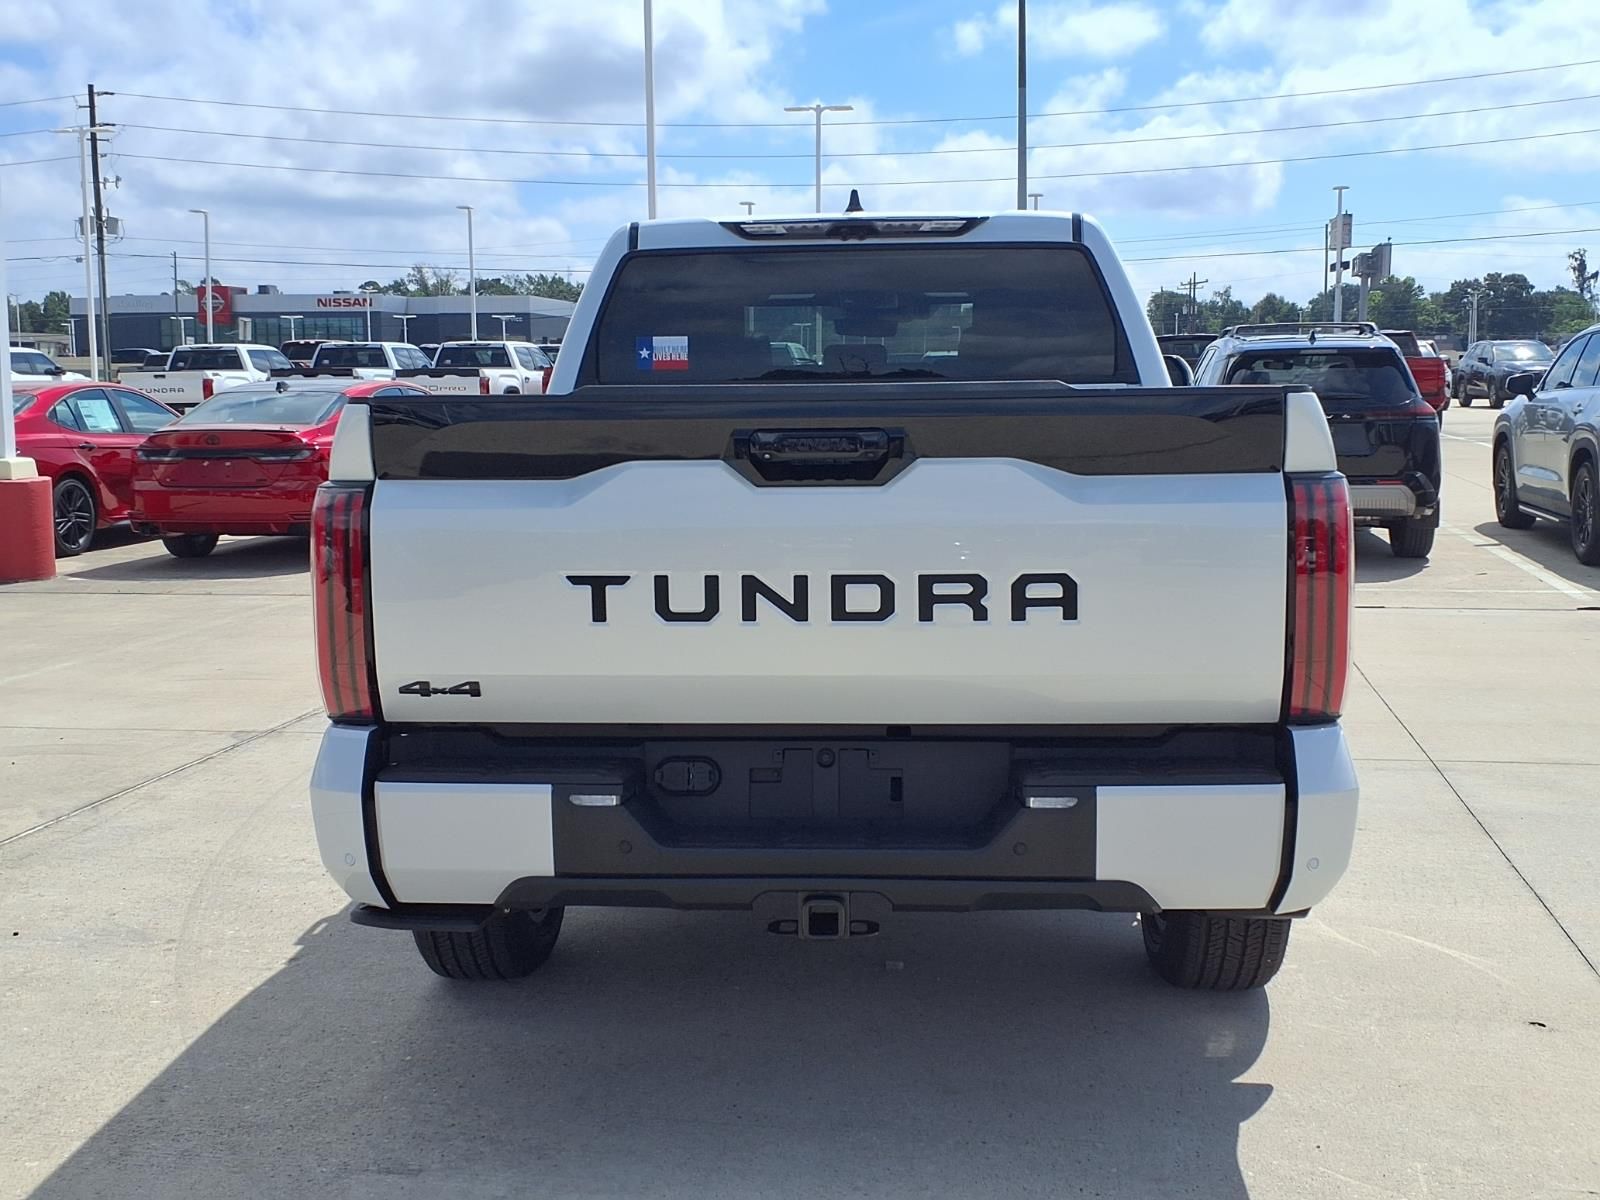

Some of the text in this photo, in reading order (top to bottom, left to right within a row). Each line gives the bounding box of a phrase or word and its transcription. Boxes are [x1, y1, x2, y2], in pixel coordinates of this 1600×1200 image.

[317, 297, 372, 307] NISSAN
[565, 573, 1078, 623] TUNDRA
[398, 680, 481, 697] 4x4
